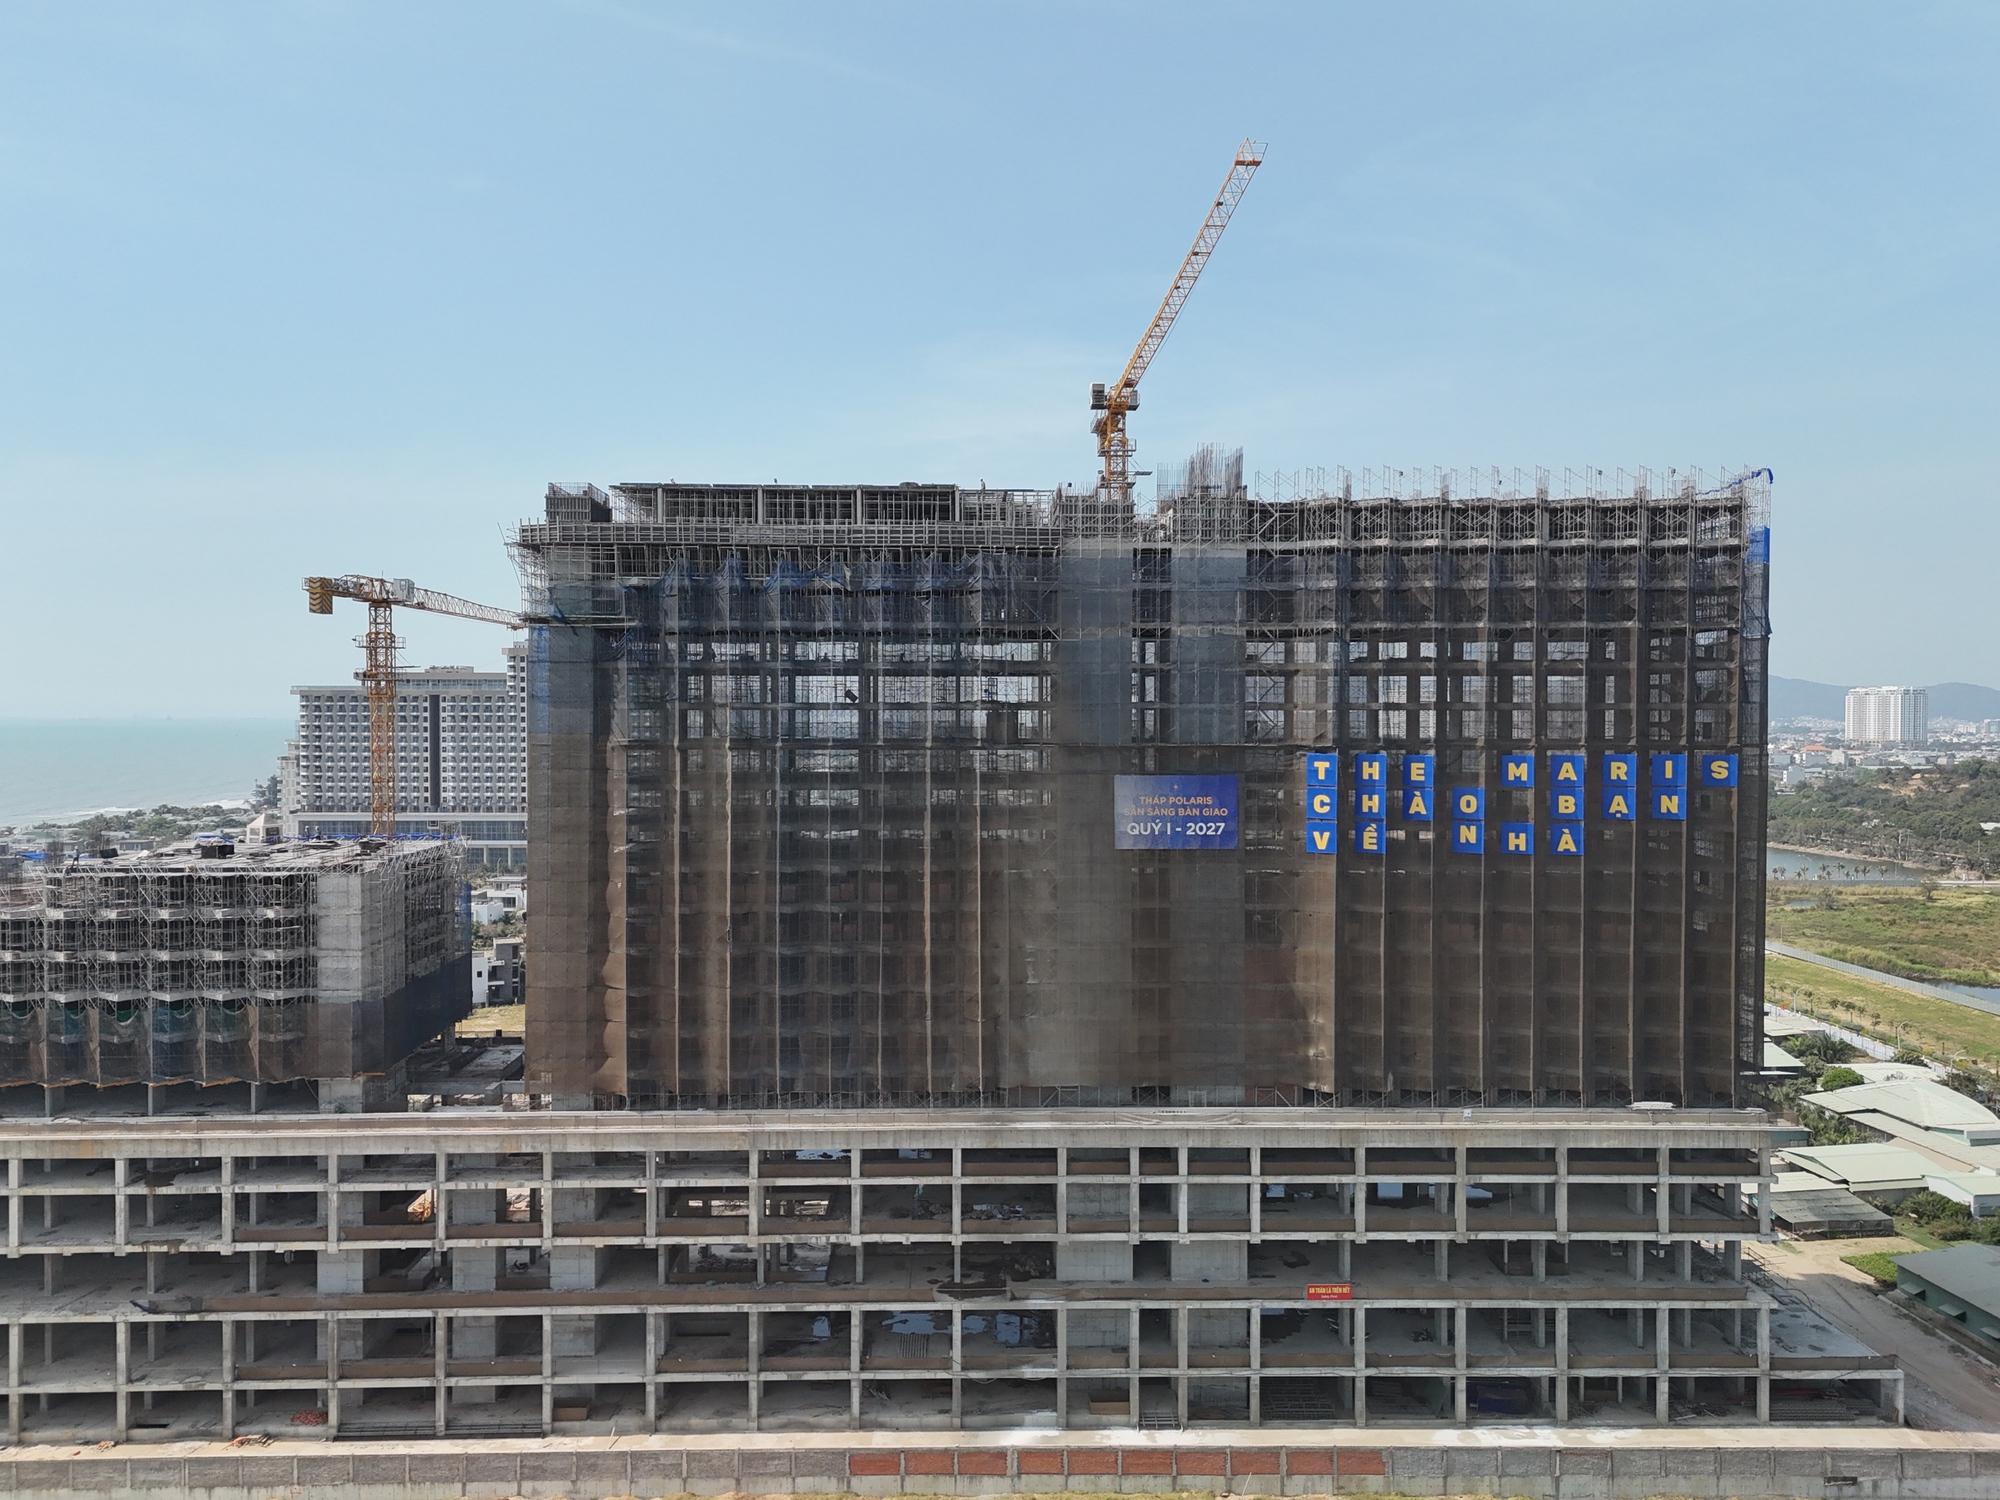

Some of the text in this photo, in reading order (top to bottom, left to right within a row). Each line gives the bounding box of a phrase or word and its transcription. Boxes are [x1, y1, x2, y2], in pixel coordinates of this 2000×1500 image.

[1315, 760, 1728, 780] THE MARIS
[1139, 795, 1213, 805] THÁP POLARIS
[1313, 791, 1678, 818] CHÀO BẠN
[1147, 806, 1176, 816] SÀNG
[1178, 806, 1200, 816] BÀN
[1202, 808, 1229, 816] GIAO
[1127, 819, 1162, 835] QUÝ
[1166, 823, 1172, 835] I
[1185, 822, 1226, 835] 2027
[1313, 823, 1576, 852] VỀ NHÀ
